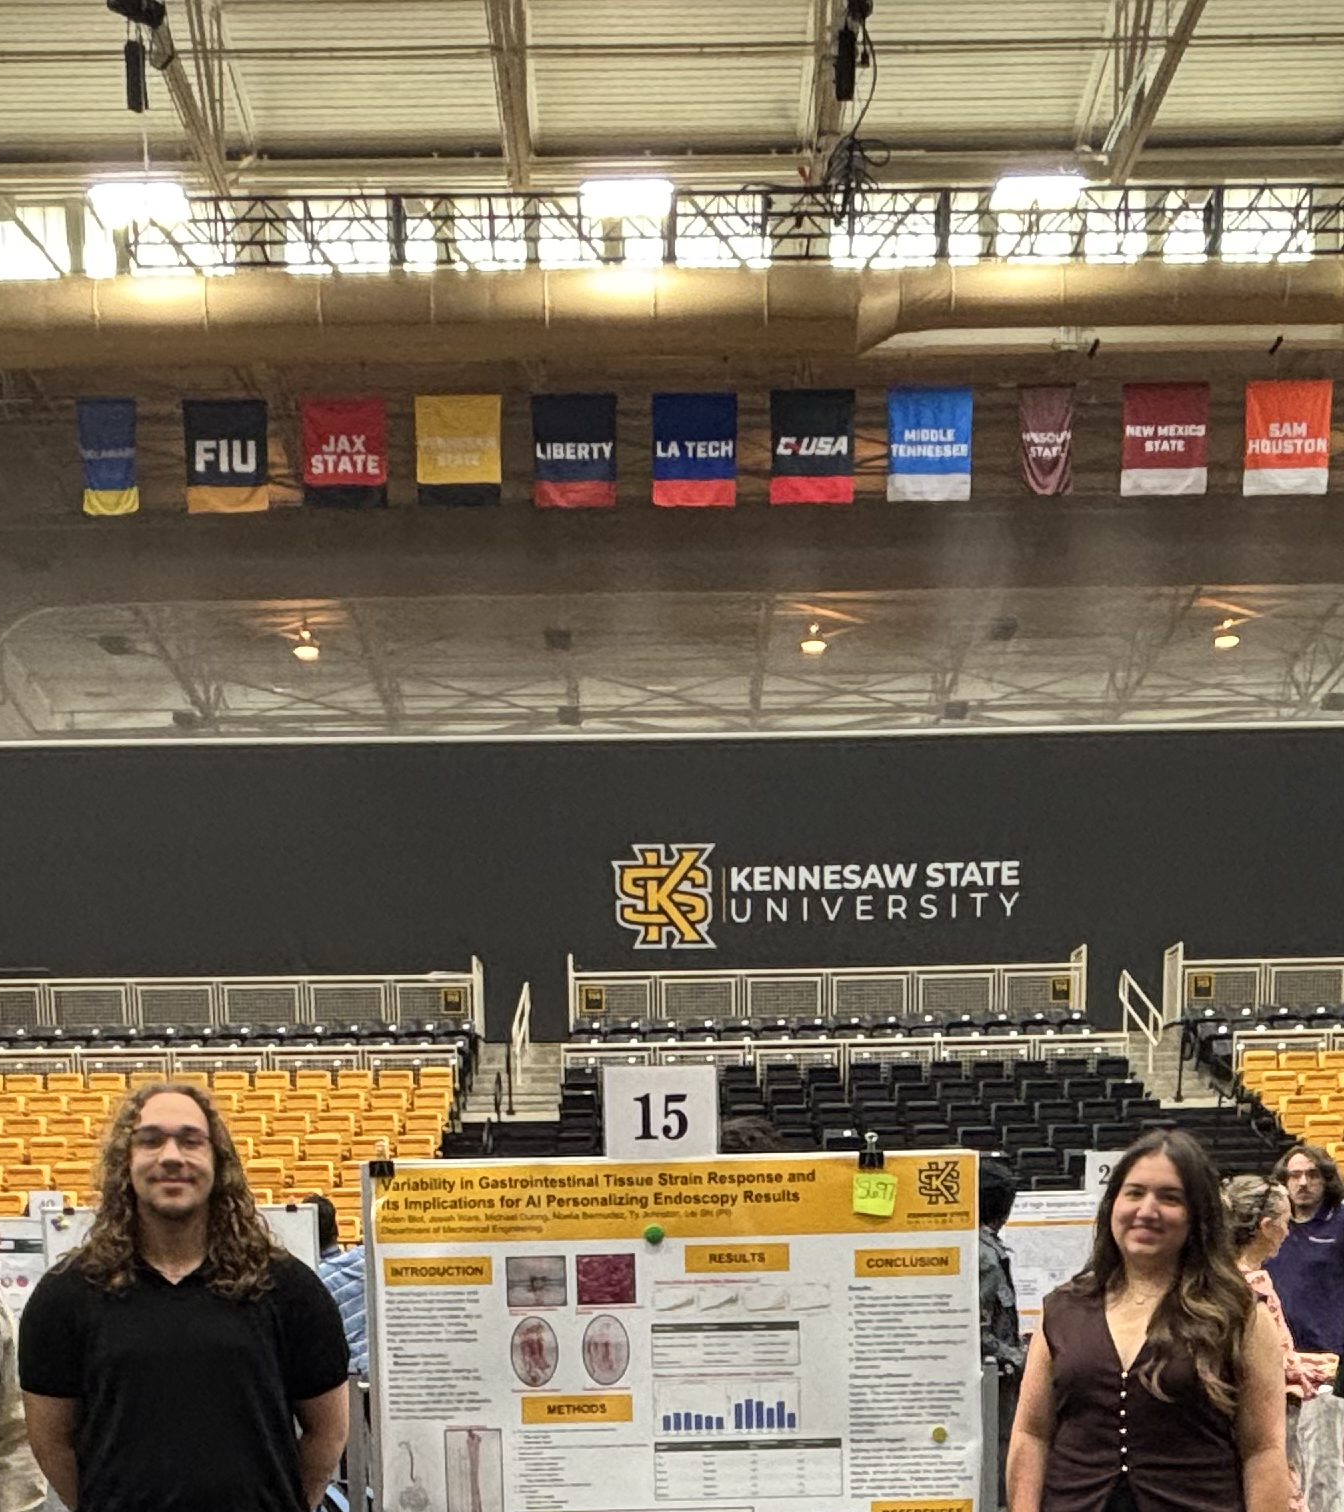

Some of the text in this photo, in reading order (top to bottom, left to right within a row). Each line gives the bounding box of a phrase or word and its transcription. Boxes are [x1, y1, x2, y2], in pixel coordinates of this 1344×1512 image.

[903, 428, 956, 442] MIDDLE
[1125, 423, 1206, 438] NEW MEXICO
[1268, 422, 1307, 438] SAM
[321, 434, 366, 454] JAX
[535, 441, 614, 461] LIBERTY
[655, 440, 734, 459] LA TECH
[890, 444, 968, 458] TENNESSEE
[1144, 439, 1186, 452] STATE
[1246, 438, 1328, 455] HOUSTON
[194, 438, 257, 474] FIU
[310, 455, 381, 475] STATE
[730, 860, 1021, 892] KENNESAW STATE
[730, 892, 1021, 923] UNIVERSITY
[632, 1092, 689, 1141] 15
[381, 1168, 816, 1194] Variability in Gastrointestinal Tissue Strain Response and
[1098, 1164, 1111, 1186] 2
[404, 1196, 496, 1213] Implications
[499, 1194, 521, 1208] for
[524, 1194, 542, 1208] AI
[546, 1192, 649, 1209] Personalizing
[653, 1190, 738, 1207] Endoscopy
[742, 1188, 801, 1203] Results
[708, 1252, 766, 1264] RESULTS
[866, 1256, 949, 1269] CONCLUSION
[390, 1265, 484, 1278] INTRODUCTION
[546, 1403, 607, 1416] METHODS
